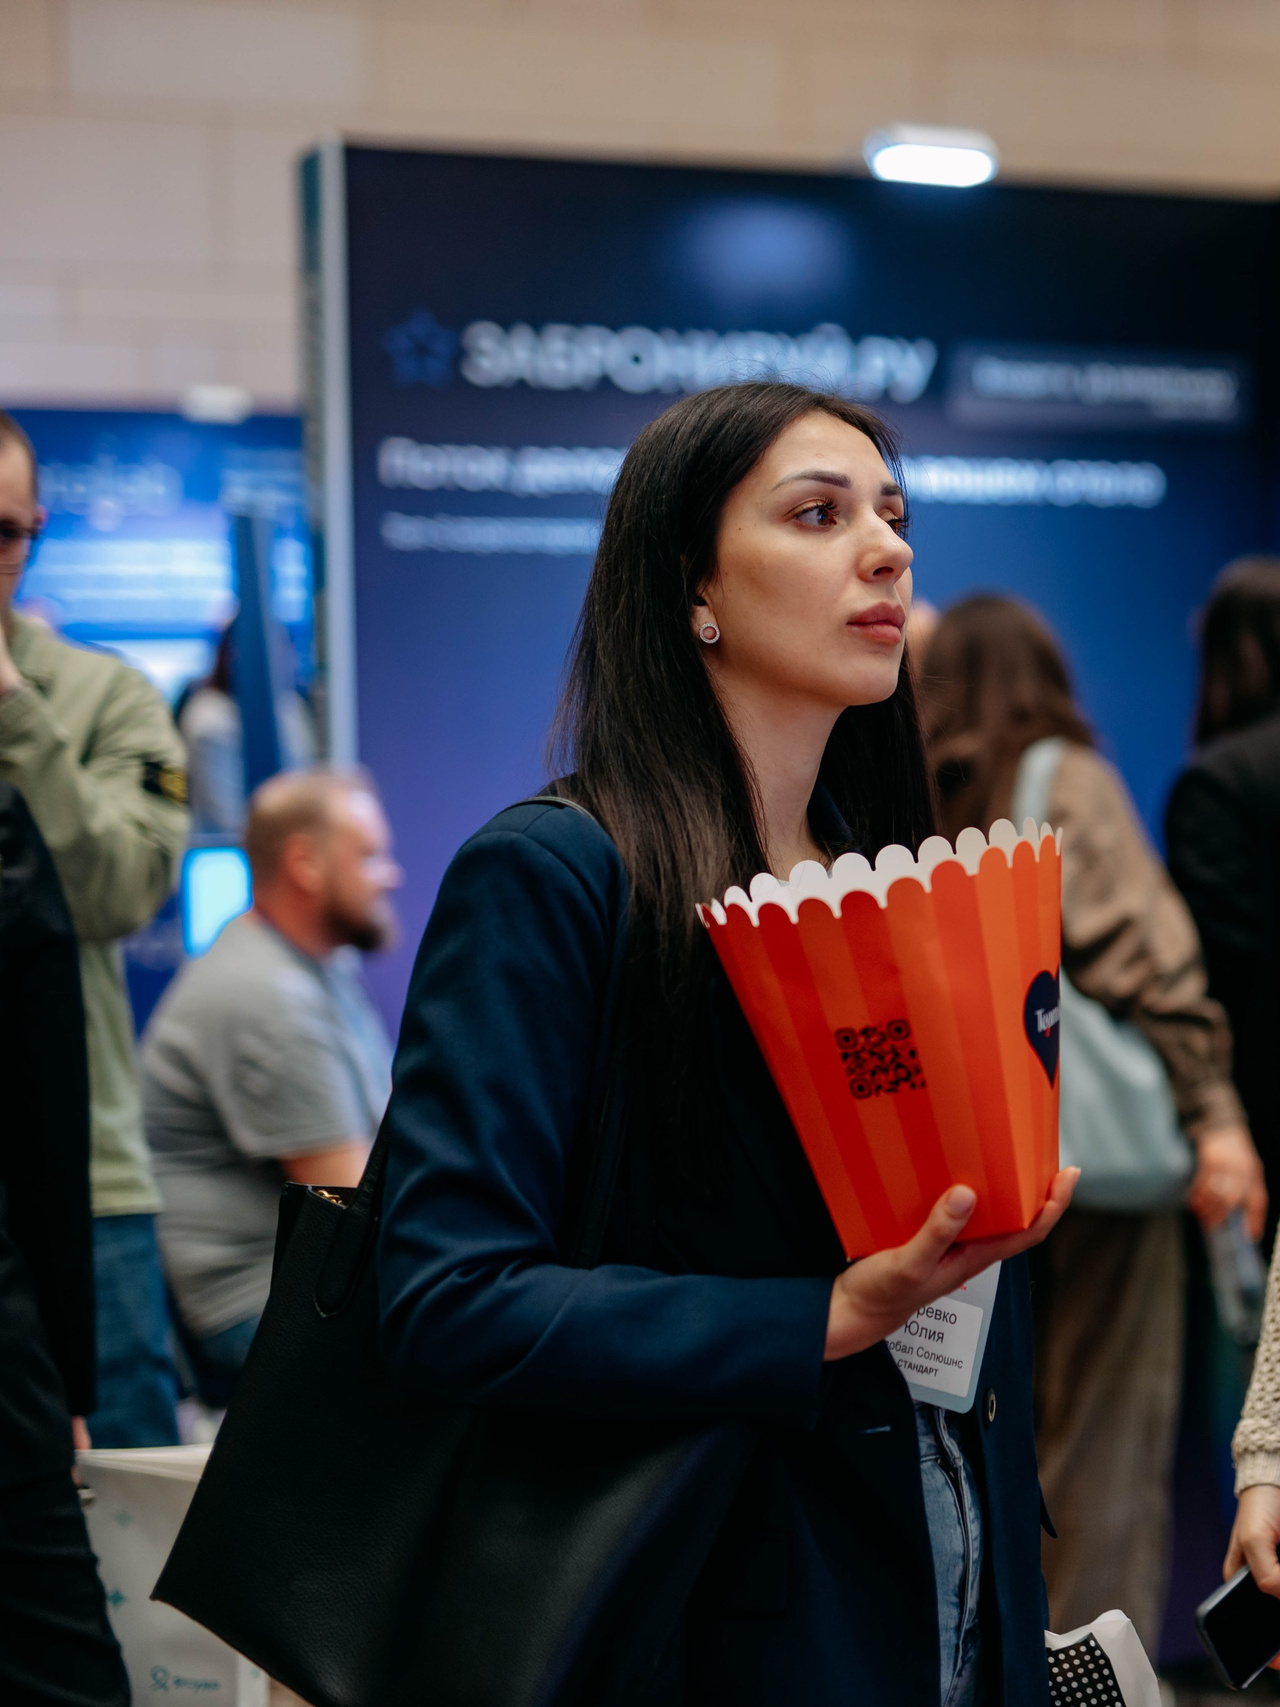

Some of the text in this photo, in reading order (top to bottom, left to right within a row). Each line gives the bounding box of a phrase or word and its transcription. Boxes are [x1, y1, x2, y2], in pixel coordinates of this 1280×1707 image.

[916, 1304, 958, 1325] ревко
[904, 1320, 945, 1344] Юлия
[897, 1359, 940, 1377] СТАНДАРТ
[916, 1347, 964, 1369] Солюшнс
